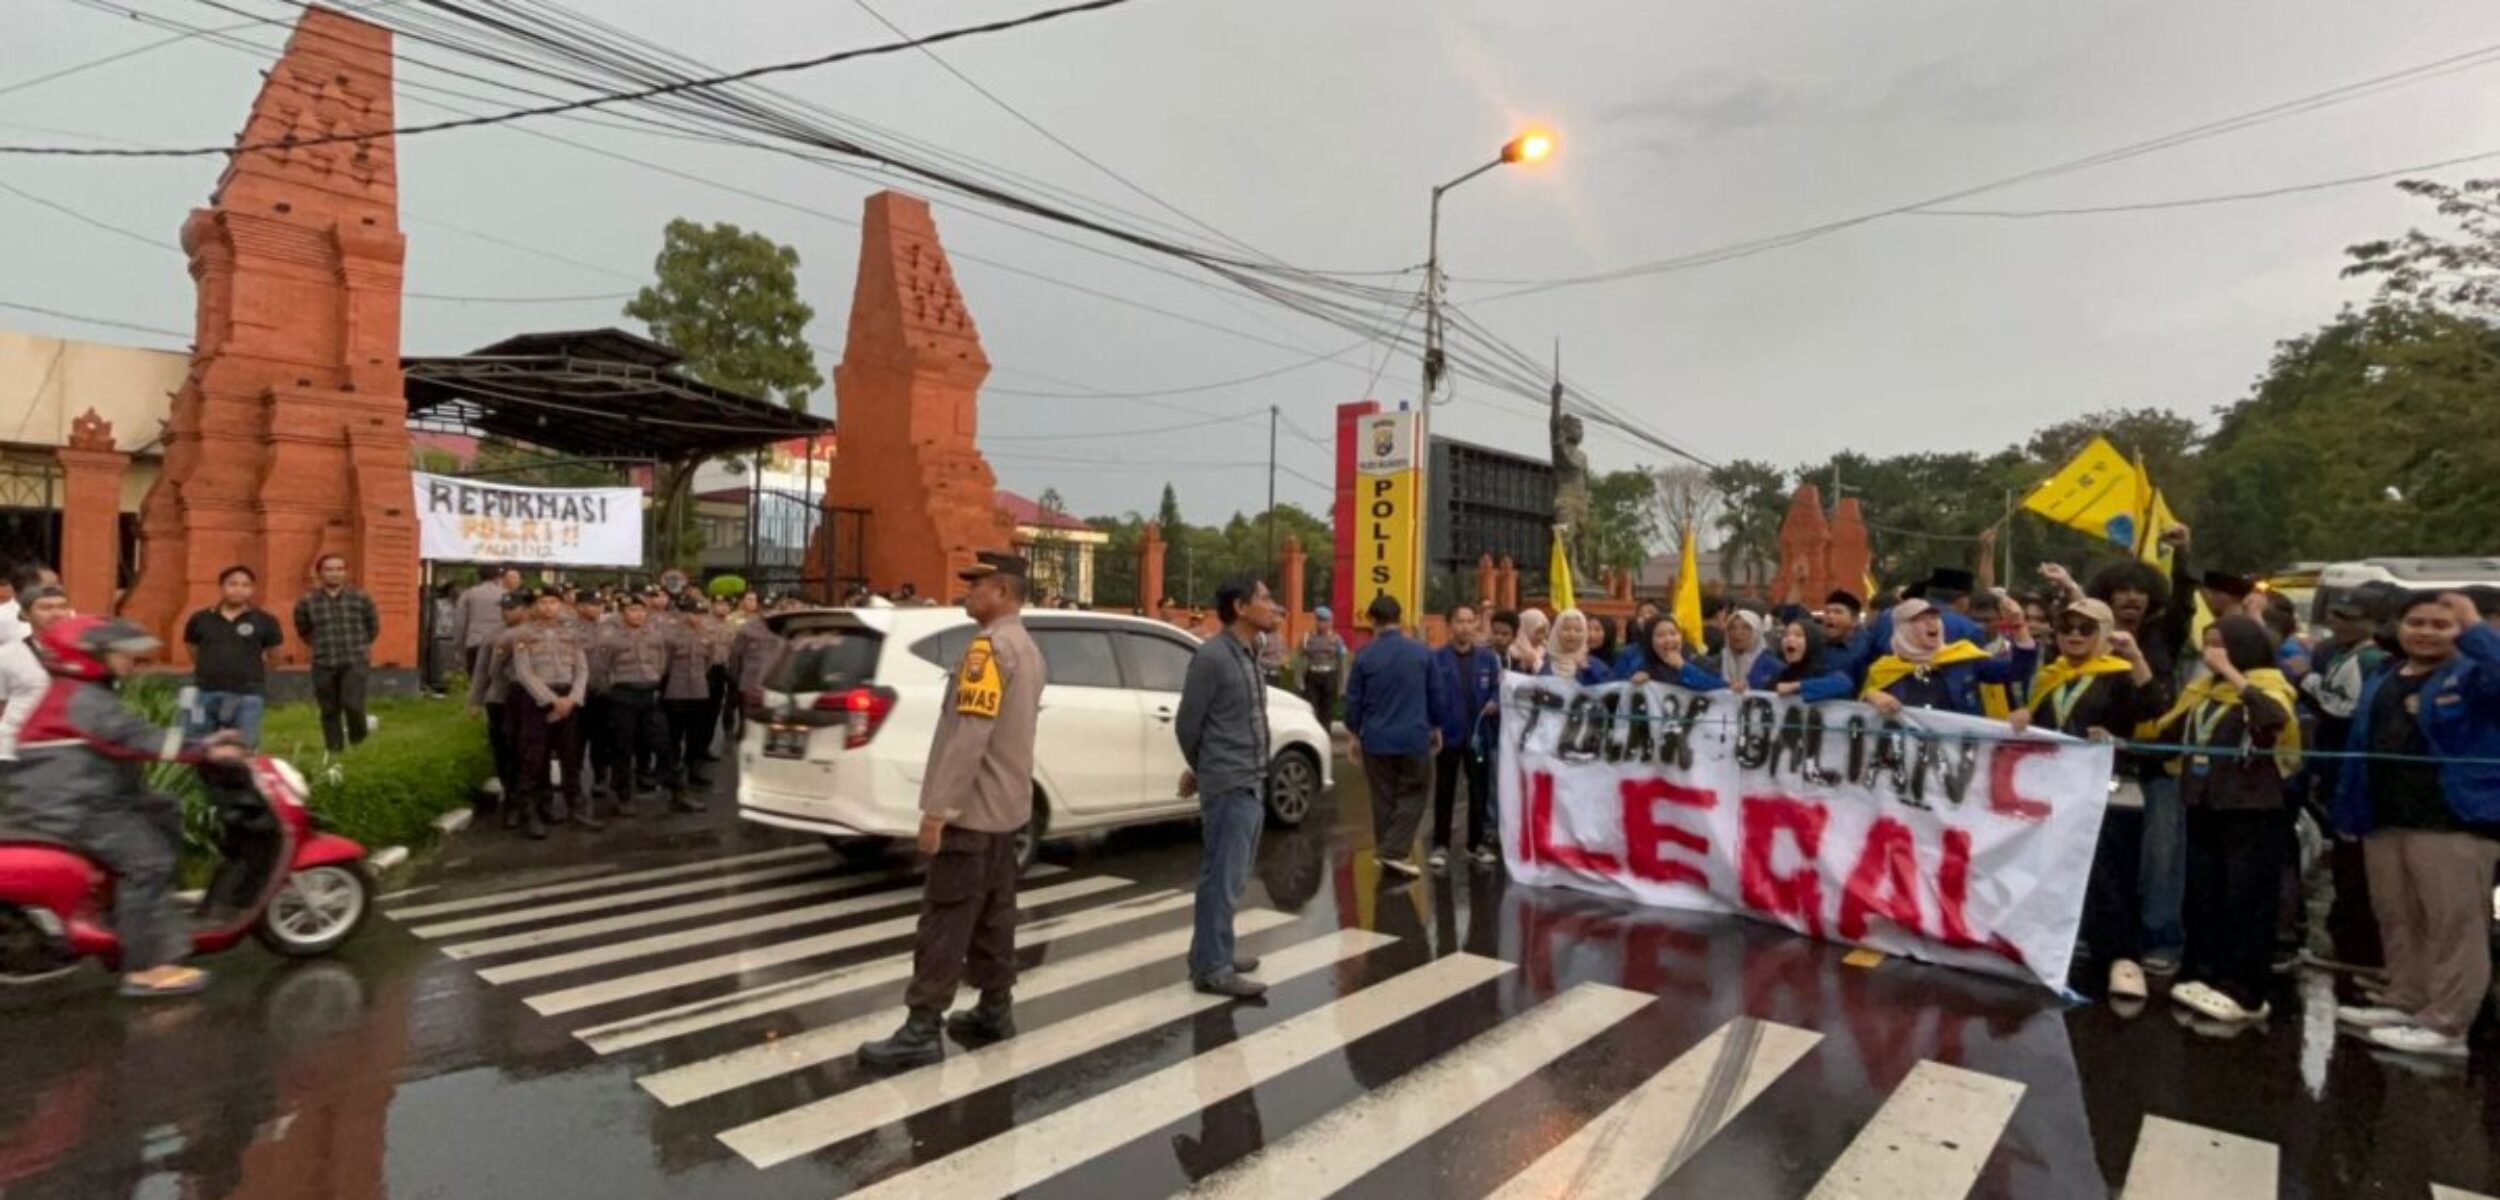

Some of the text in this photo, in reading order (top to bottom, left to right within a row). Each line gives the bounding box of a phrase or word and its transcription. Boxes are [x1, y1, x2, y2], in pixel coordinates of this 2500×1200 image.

[429, 482, 607, 524] REFORMASI
[1513, 690, 1711, 770] TOLAK
[1987, 738, 2061, 817] C
[1519, 768, 2024, 965] ILEGAL
